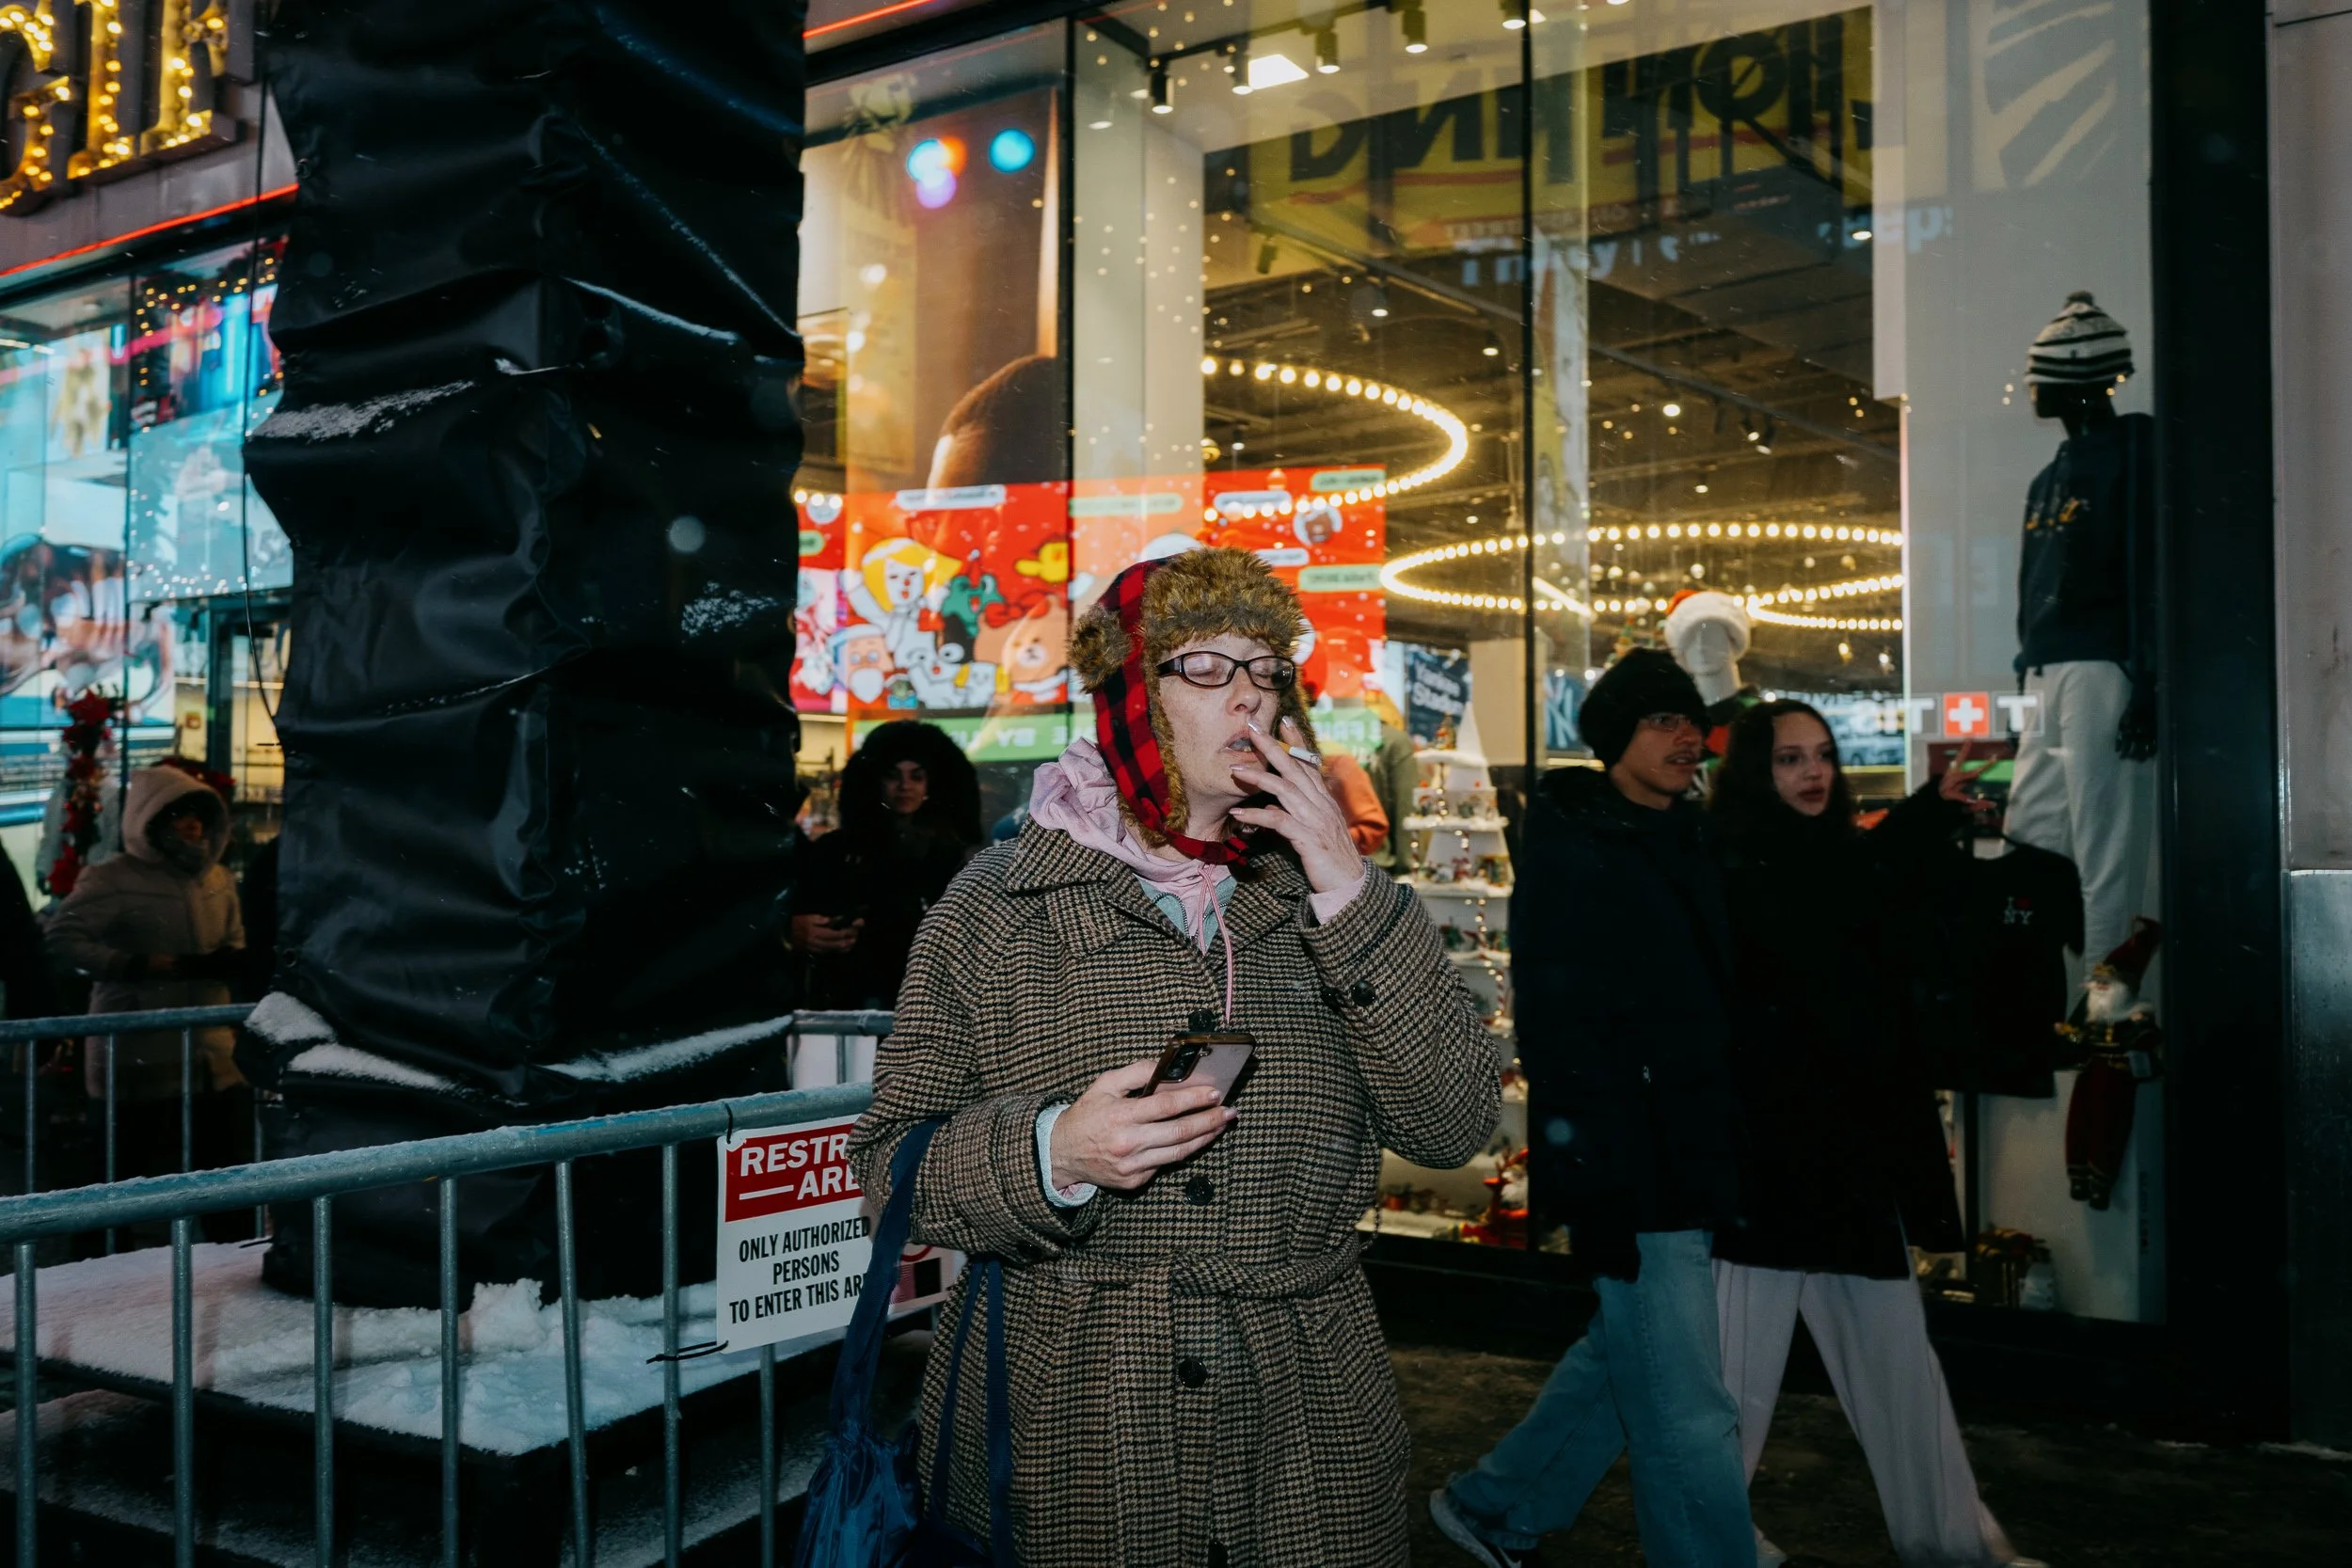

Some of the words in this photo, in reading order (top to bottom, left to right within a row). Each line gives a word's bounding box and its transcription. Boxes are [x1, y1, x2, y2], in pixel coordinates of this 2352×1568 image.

[739, 1233, 779, 1263] ONLY
[782, 1215, 871, 1254] AUTHORIZED
[772, 1250, 840, 1285] PERSONS
[729, 1299, 750, 1324] TO
[755, 1288, 803, 1319] ENTER
[805, 1278, 840, 1307] THIS
[844, 1273, 866, 1299] AR
